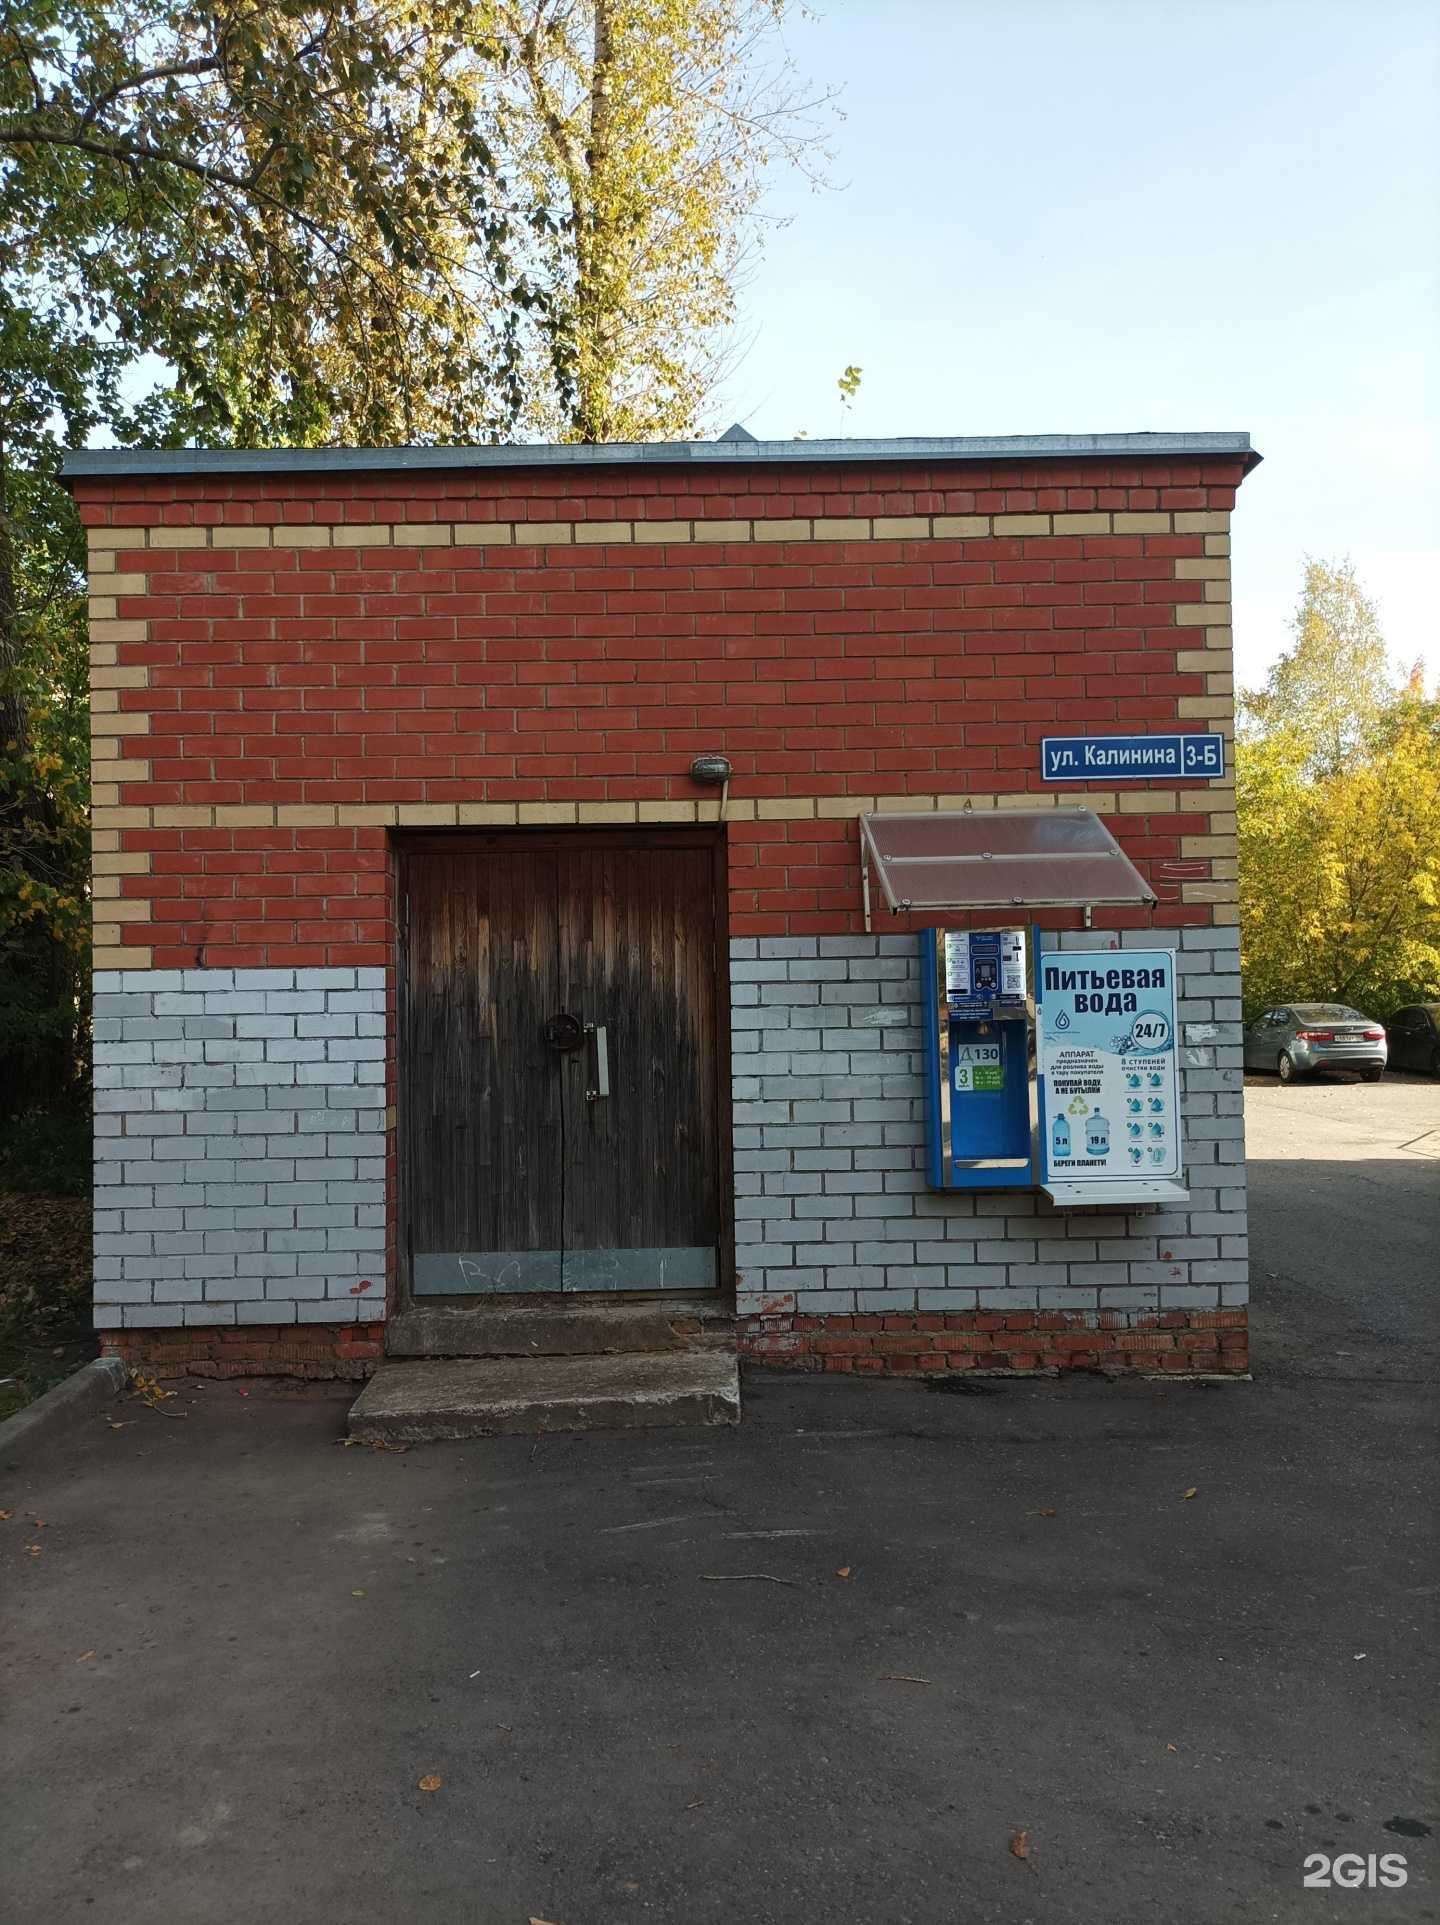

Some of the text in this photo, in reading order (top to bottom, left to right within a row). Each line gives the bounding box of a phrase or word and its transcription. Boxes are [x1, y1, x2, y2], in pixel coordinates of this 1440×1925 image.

[1051, 744, 1217, 772] ул. Калинина 3-Б
[1045, 967, 1166, 991] Питьевая
[1074, 992, 1137, 1017] вода
[1135, 1023, 1166, 1038] 24/7
[1059, 1050, 1096, 1058] АППАРАТ
[1129, 1057, 1166, 1065] СТУПЕНЕЙ
[960, 1068, 968, 1084] 3
[1053, 1078, 1083, 1087] ПОКУПАЙ
[1070, 1086, 1101, 1094] БУТЫЛКИ
[1055, 1136, 1061, 1145] 5
[1091, 1136, 1099, 1144] 19
[1076, 1159, 1107, 1167] ПЛАНЕТУ!
